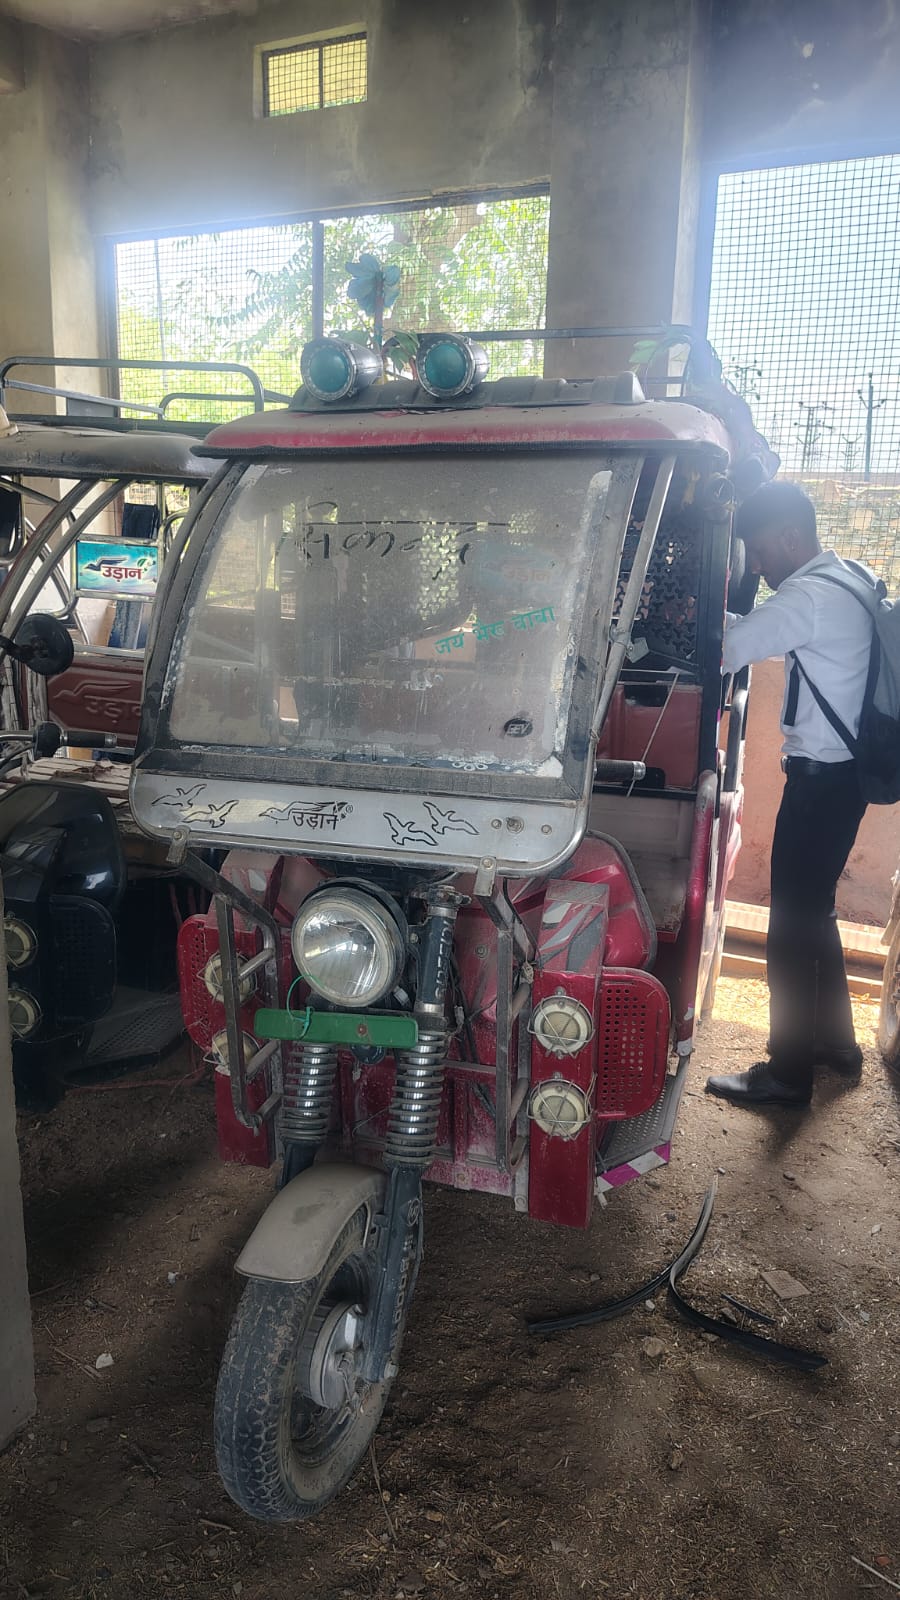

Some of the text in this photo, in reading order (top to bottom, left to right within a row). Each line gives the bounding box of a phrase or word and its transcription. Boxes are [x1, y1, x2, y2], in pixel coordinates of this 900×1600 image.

[102, 565, 144, 583] उड़ान
[434, 633, 465, 655] जय
[292, 810, 340, 831] उड़ान
